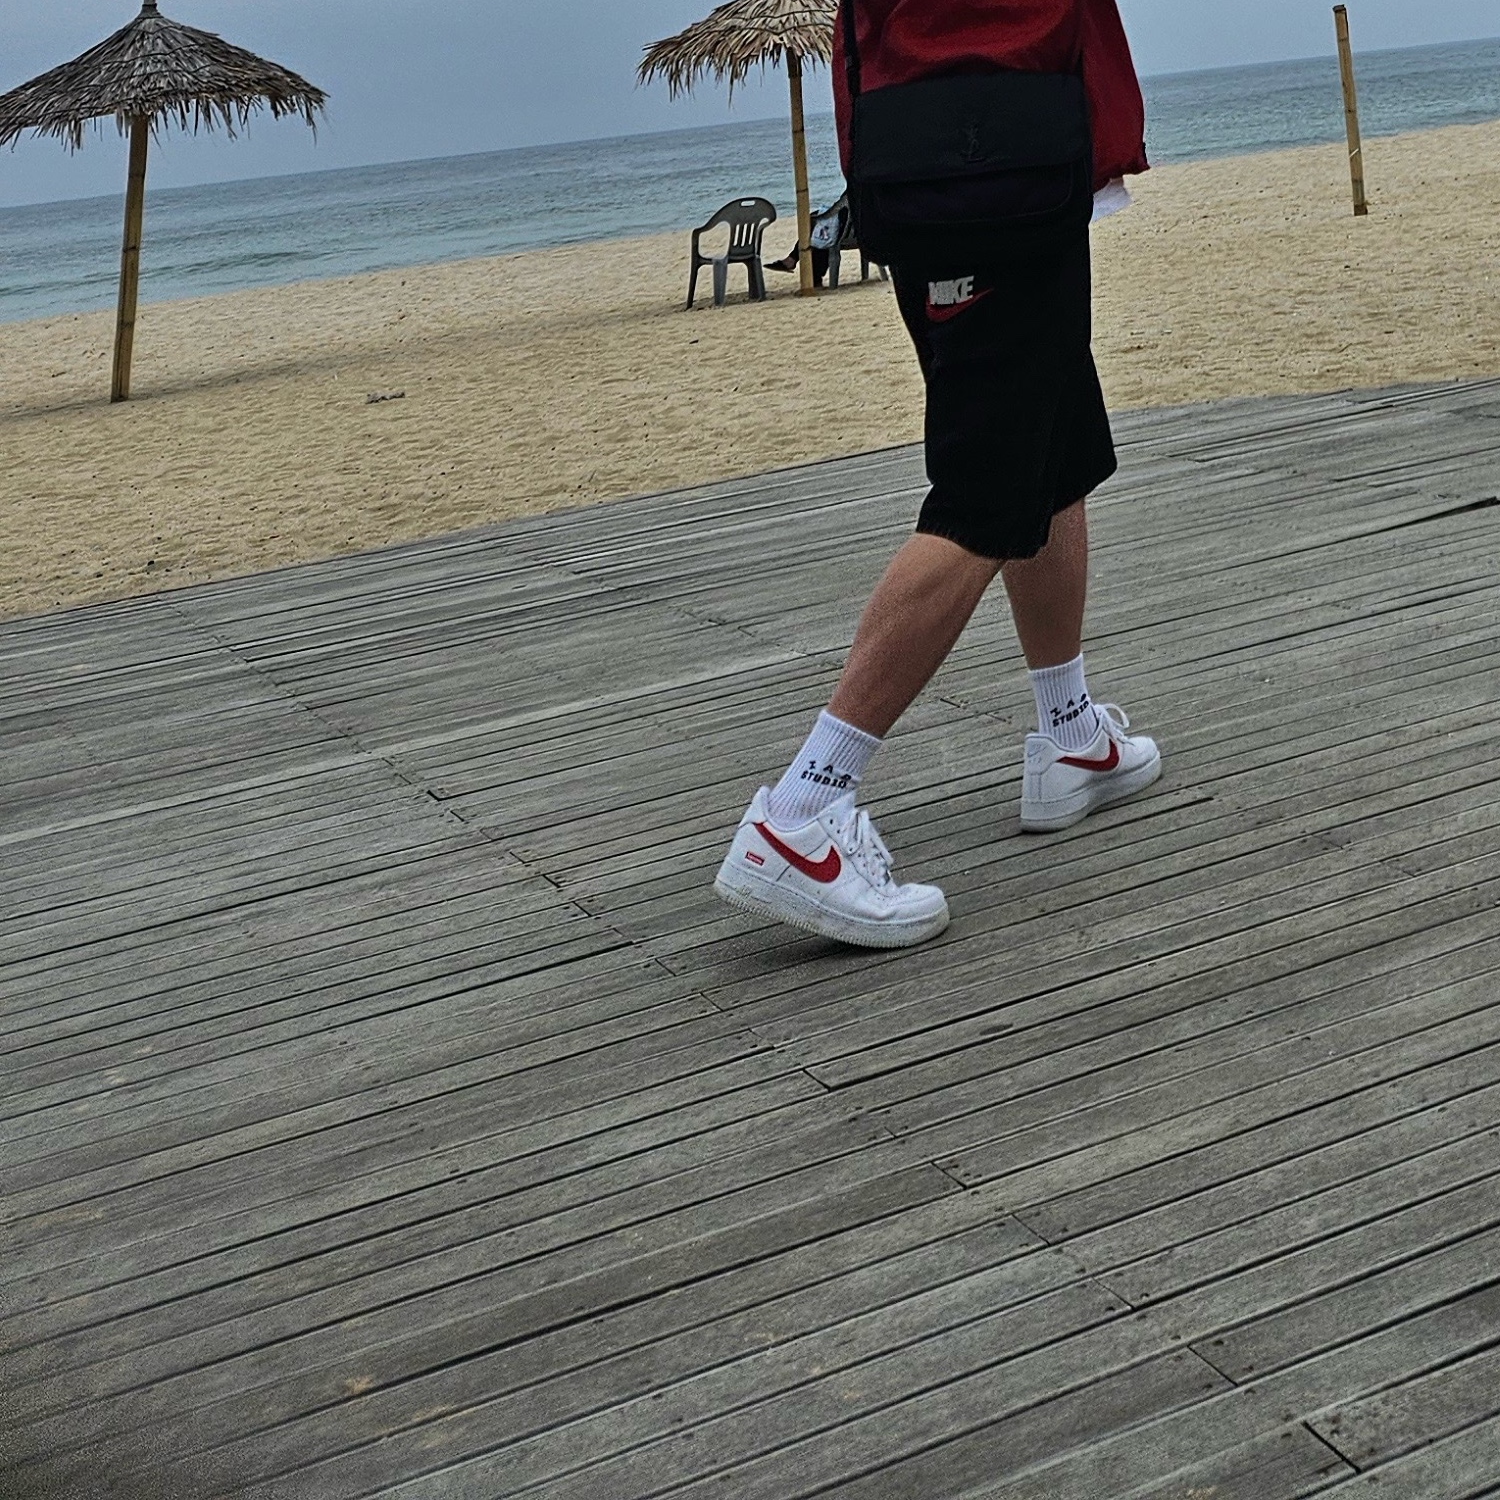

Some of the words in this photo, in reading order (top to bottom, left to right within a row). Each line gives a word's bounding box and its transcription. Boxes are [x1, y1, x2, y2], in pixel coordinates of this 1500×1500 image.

[928, 274, 974, 305] NIKE
[1052, 700, 1089, 727] STUDIO
[800, 770, 847, 789] STUDIO
